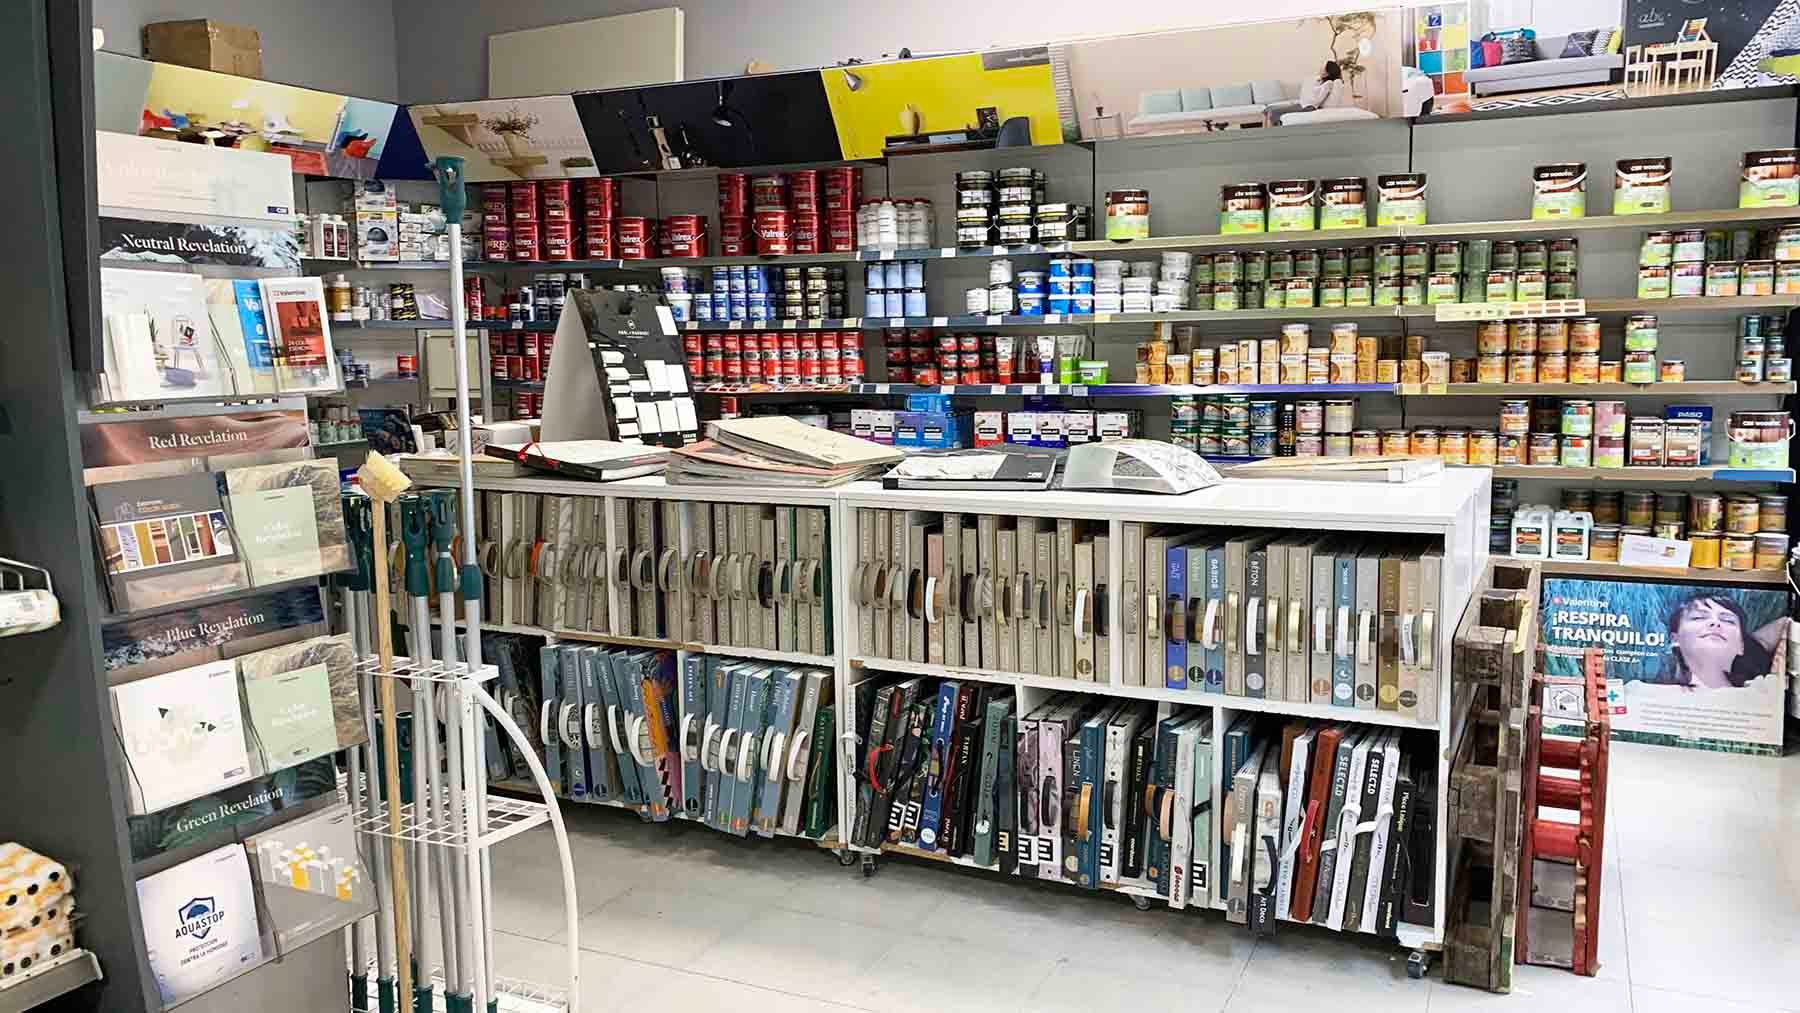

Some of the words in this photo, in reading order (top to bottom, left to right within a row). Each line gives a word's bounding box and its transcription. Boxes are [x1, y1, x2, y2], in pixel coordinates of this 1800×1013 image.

[121, 232, 175, 252] Neutral
[177, 237, 248, 255] Revelation
[149, 433, 178, 450] Red
[180, 428, 248, 446] Revelation
[1250, 560, 1261, 587] BÉTON
[1562, 597, 1609, 608] Valentine
[164, 626, 198, 643] Blue
[199, 612, 265, 636] Revelation
[1552, 611, 1632, 628] ¡RESPIRA
[1552, 627, 1666, 647] TRANQUILO!
[960, 735, 970, 766] TARTAN
[1334, 755, 1349, 797] SELECT.D
[1366, 758, 1380, 795] SELECT.D
[176, 809, 217, 833] Green
[219, 786, 285, 819] Revelation
[1259, 896, 1267, 908] Art
[174, 911, 225, 939] AQUASTOP
[1258, 908, 1267, 924] Deco
